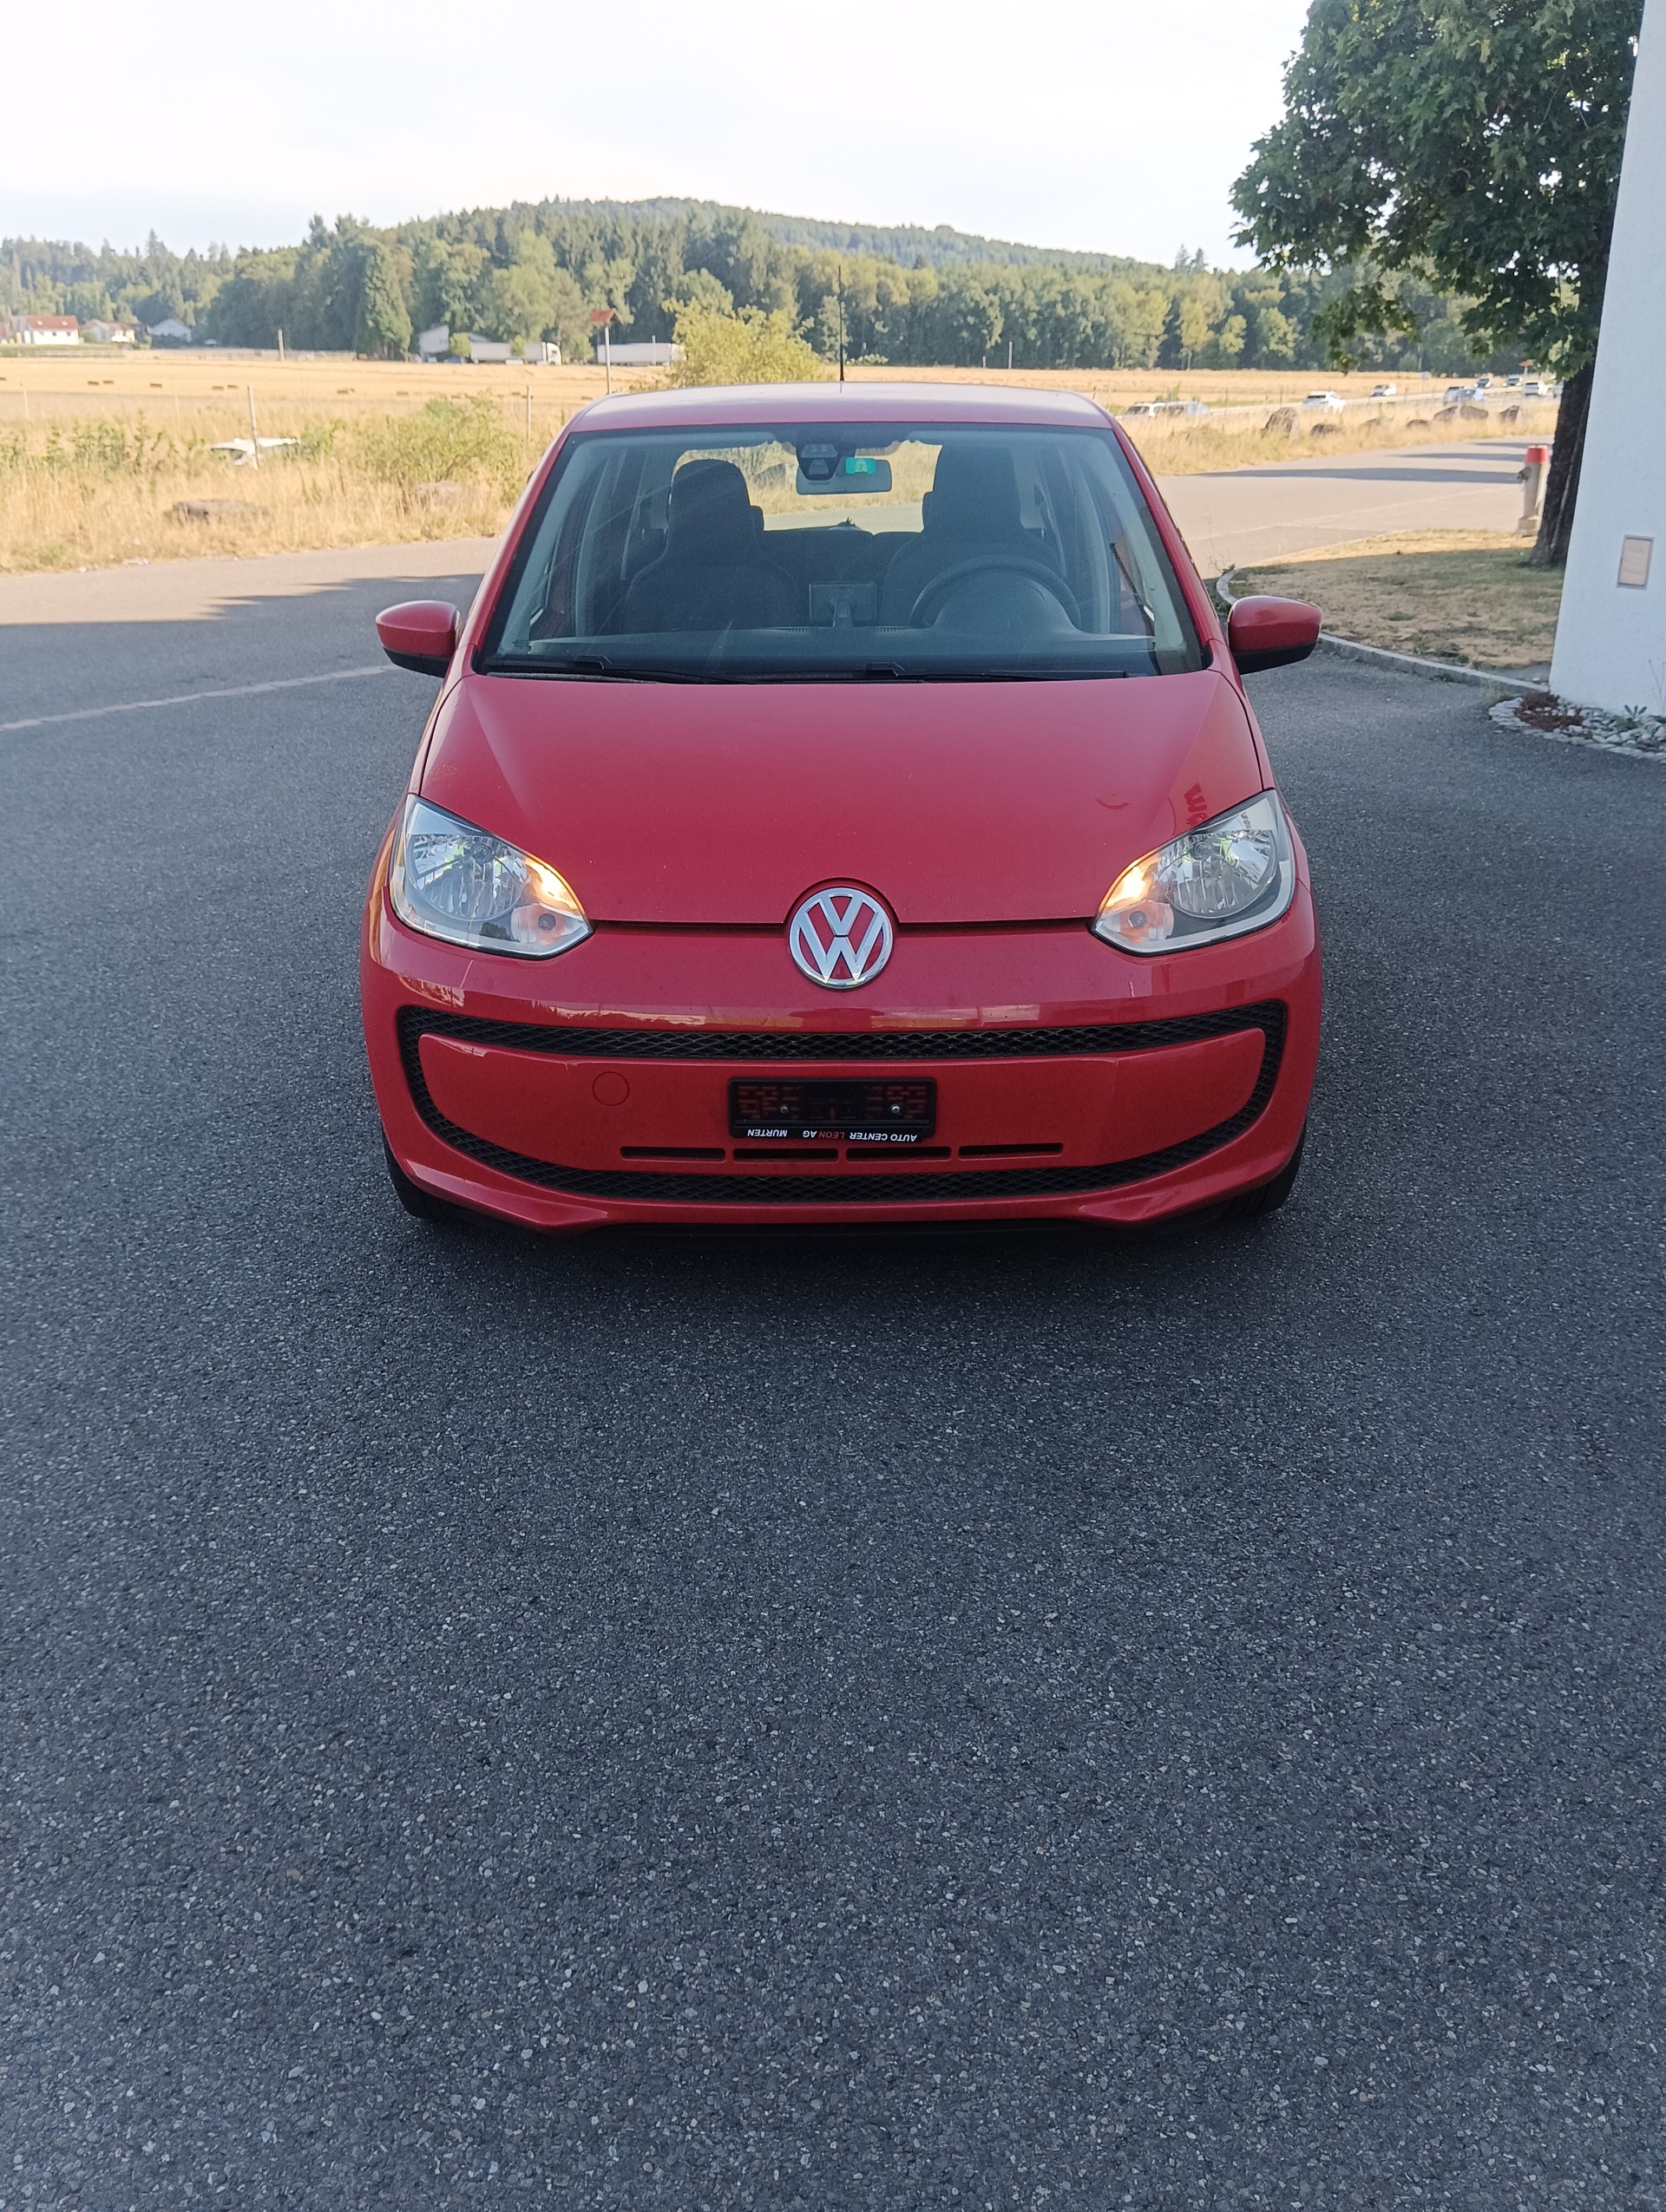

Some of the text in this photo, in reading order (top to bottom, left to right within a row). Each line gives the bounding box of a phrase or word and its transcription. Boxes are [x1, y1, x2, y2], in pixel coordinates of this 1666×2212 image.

[792, 889, 890, 986] VW
[747, 1129, 918, 1142] AUTO CENTER LEON AG MURTEN
